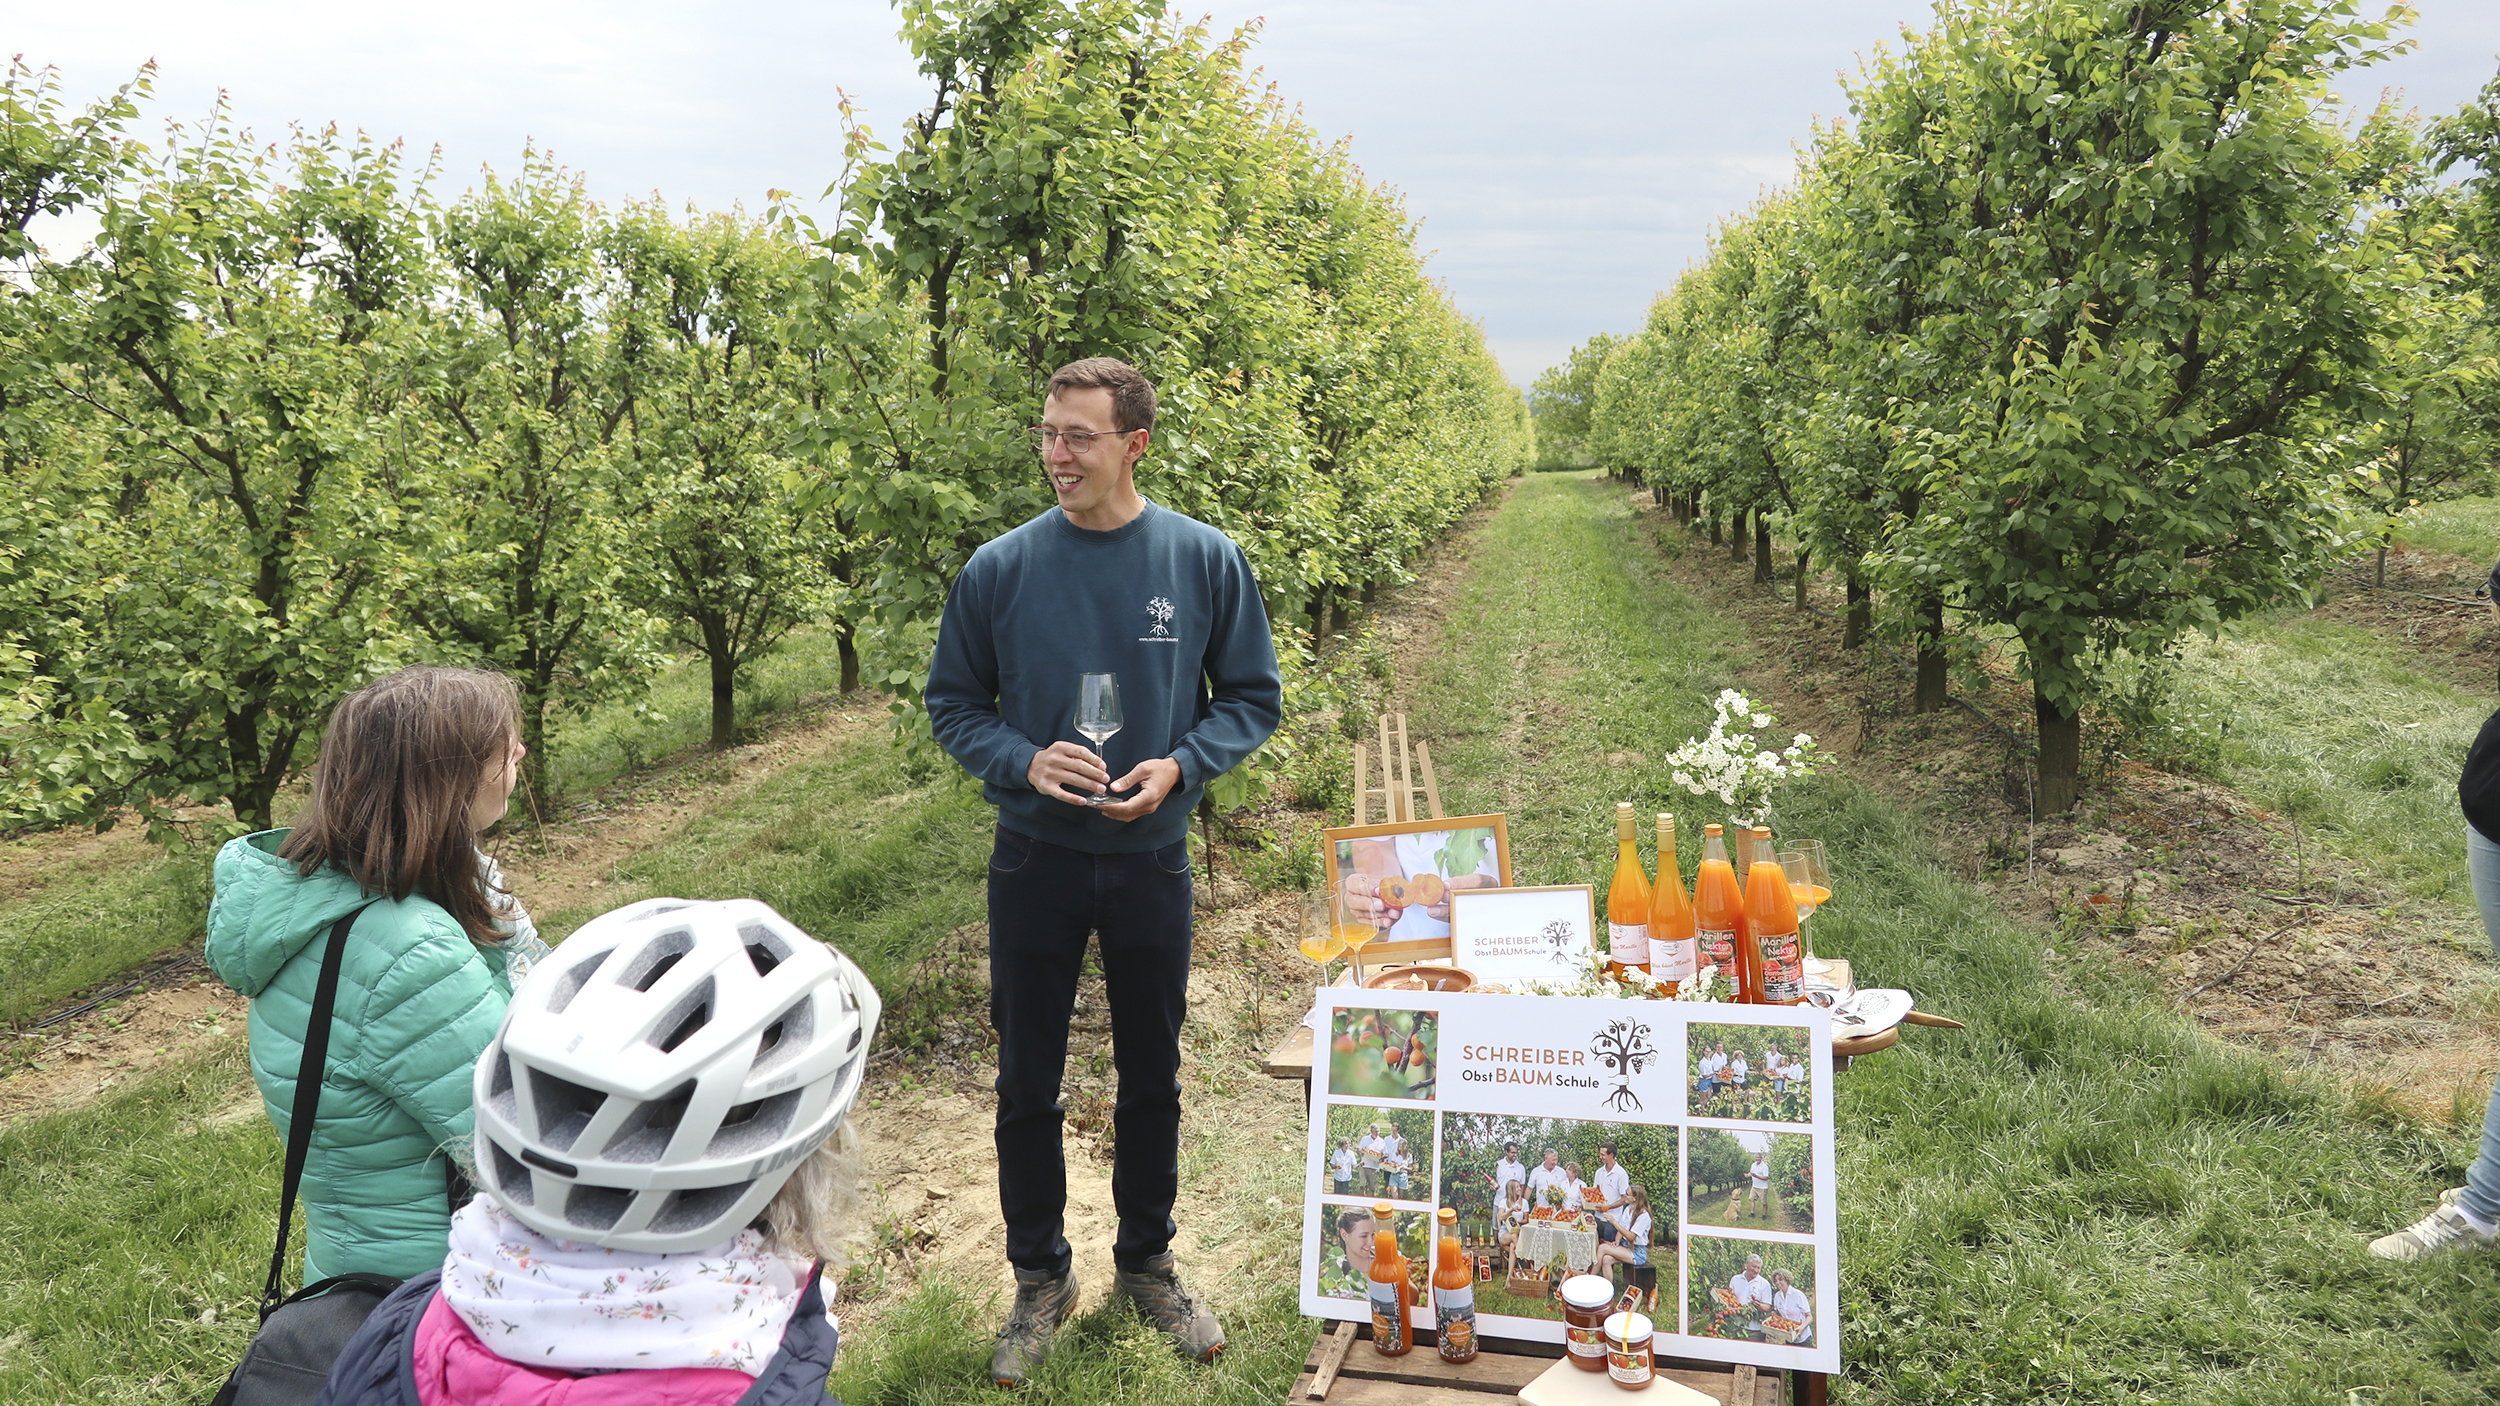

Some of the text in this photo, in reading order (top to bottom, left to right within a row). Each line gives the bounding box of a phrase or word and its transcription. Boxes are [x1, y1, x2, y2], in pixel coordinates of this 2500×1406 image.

[1697, 930, 1734, 940] Marillen
[1760, 934, 1797, 946] Marillen
[1474, 936, 1539, 946] SCHREIBER
[1701, 940, 1731, 951] Nektar
[1492, 947, 1523, 956] BAUM
[1767, 945, 1797, 956] Nektar
[1463, 1045, 1585, 1066] SCHREIBER
[1462, 1068, 1600, 1089] Obst BAUM Schule
